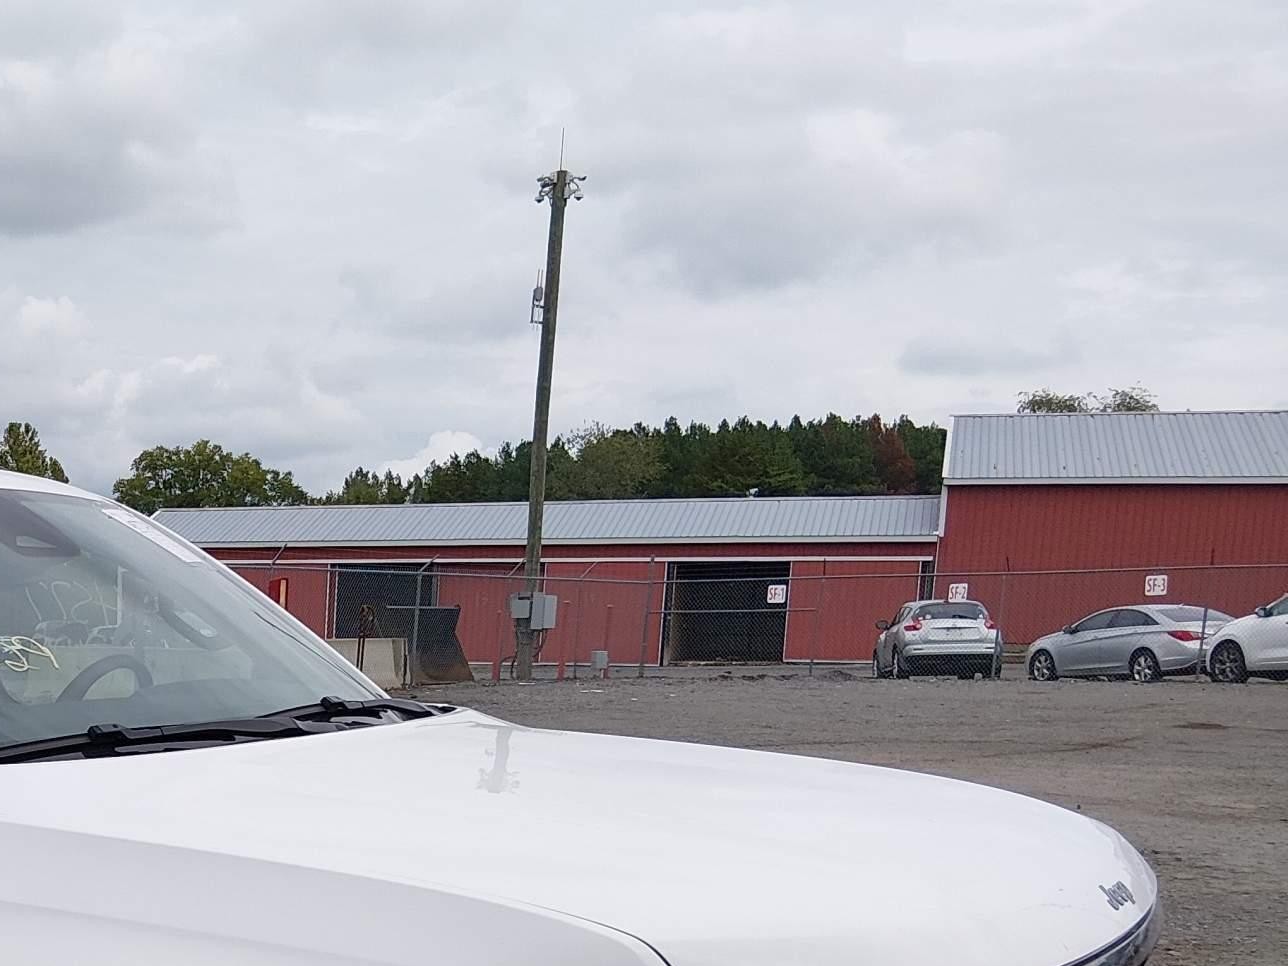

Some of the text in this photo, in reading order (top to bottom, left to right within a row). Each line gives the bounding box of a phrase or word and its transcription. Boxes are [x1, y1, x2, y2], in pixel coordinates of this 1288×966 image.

[949, 585, 967, 600] SF-2
[1146, 577, 1166, 593] SF-3
[768, 586, 785, 601] SF-1
[1098, 881, 1136, 911] Jeep
